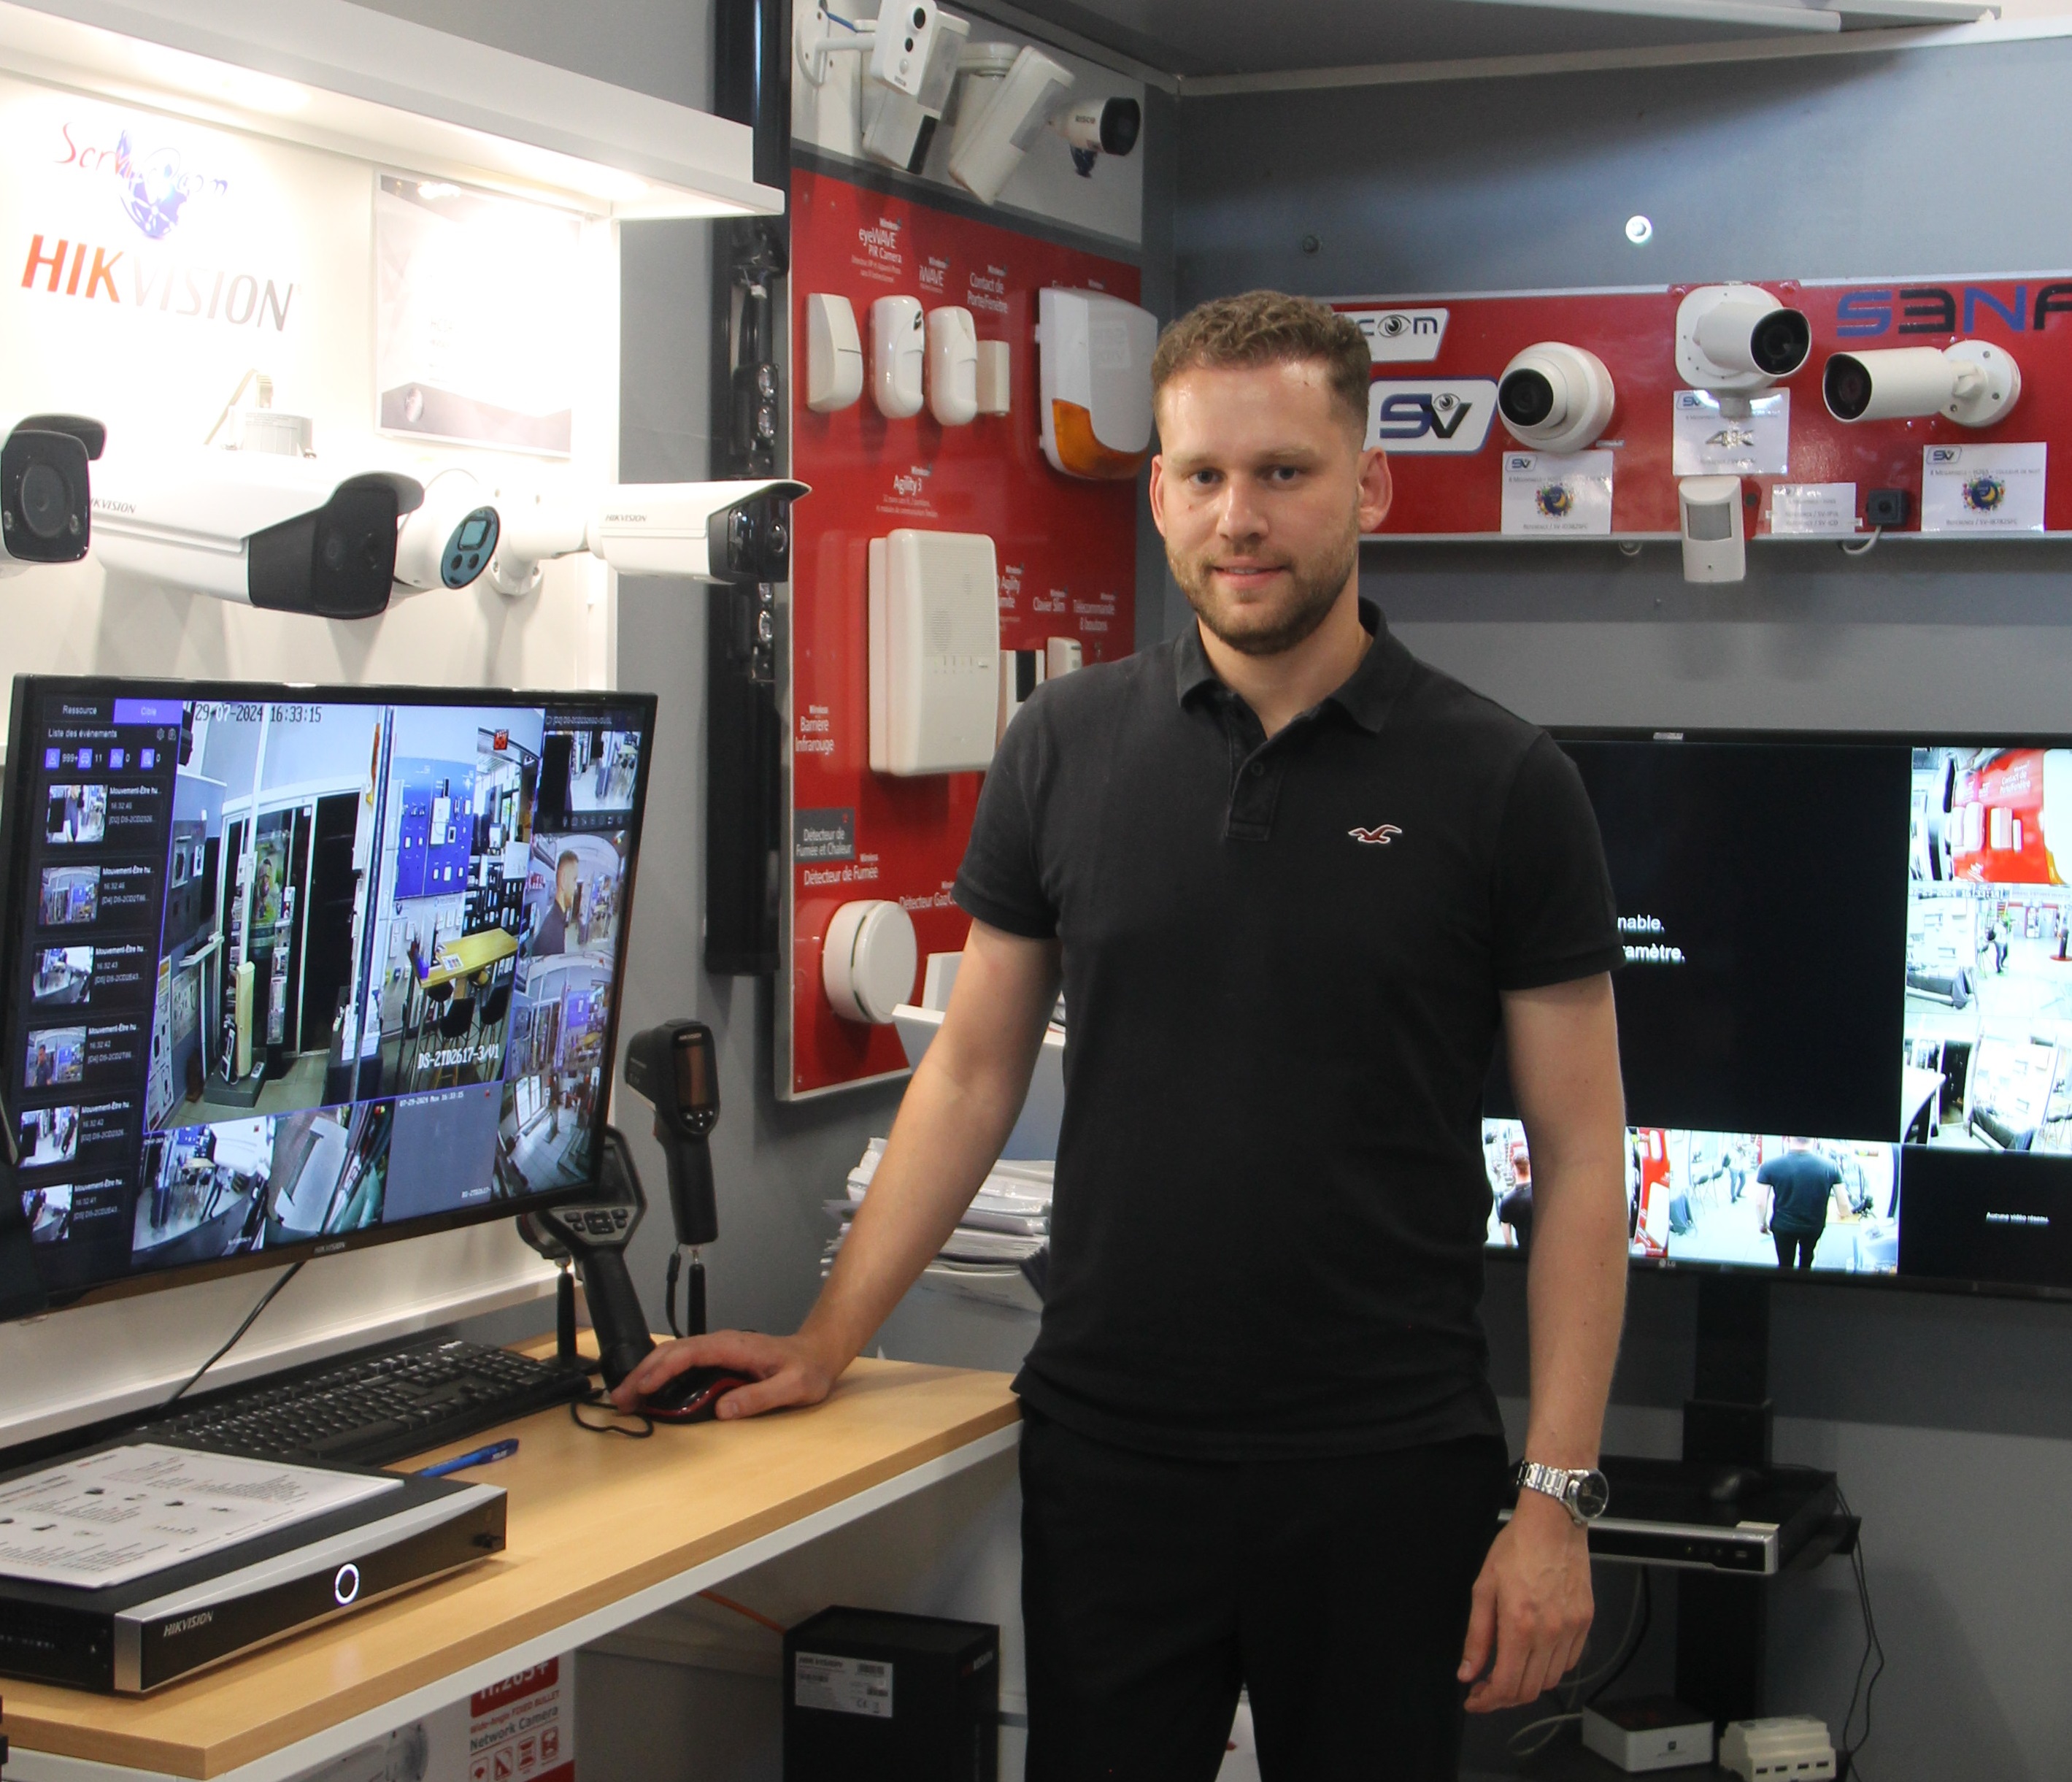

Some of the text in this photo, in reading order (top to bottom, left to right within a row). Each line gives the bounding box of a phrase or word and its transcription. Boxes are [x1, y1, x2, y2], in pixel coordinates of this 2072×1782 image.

[859, 228, 896, 249] eyeWAVE
[21, 234, 293, 331] HIKVISION
[970, 272, 1004, 294] Contact de
[893, 475, 917, 496] Agility
[605, 514, 647, 522] HIKVISION
[63, 704, 97, 715] Ressource
[271, 705, 322, 722] 16:33:15
[48, 729, 118, 738] Liste des événements
[796, 734, 834, 756] Infrarouge
[62, 753, 78, 763] 999+
[804, 827, 845, 842] Détecteur de
[796, 842, 852, 857] Fumée et Chaleur
[804, 863, 879, 886] Détecteur de Fumée
[899, 895, 933, 910] Détecteur
[163, 1611, 213, 1637] HIKVISION
[470, 1706, 558, 1751] Network Camera
